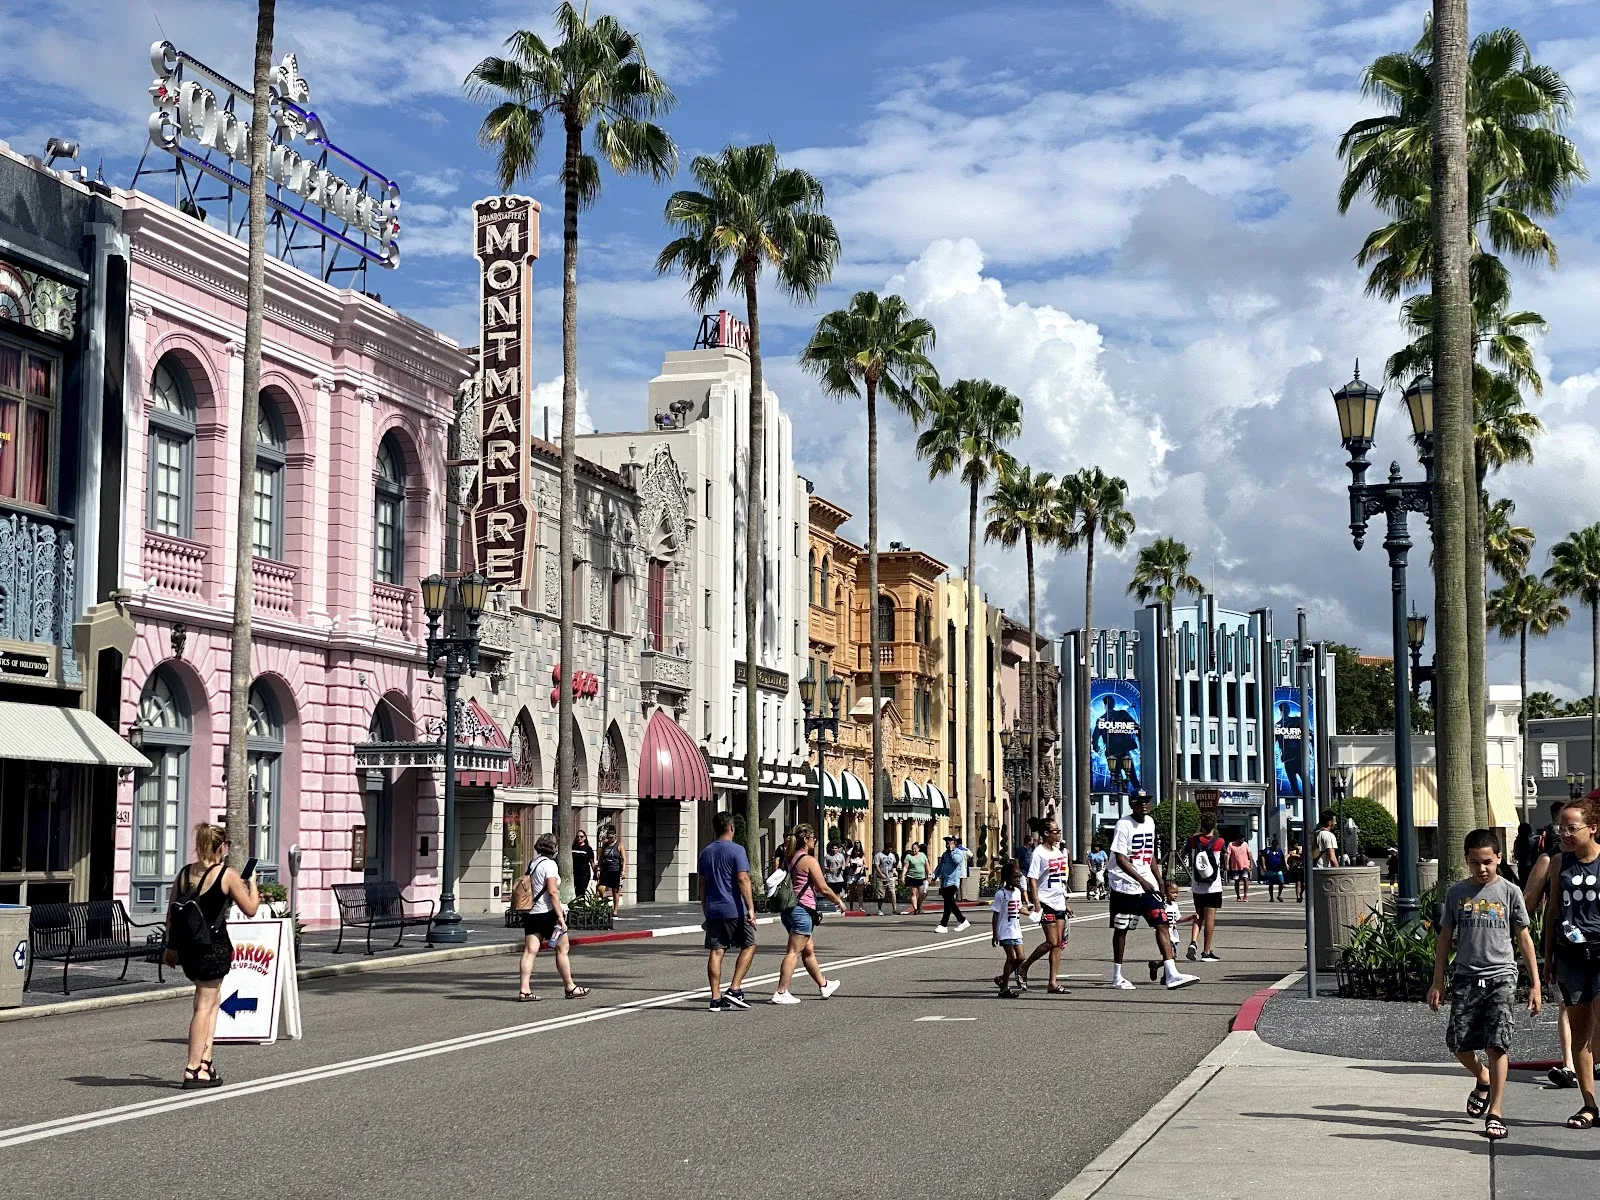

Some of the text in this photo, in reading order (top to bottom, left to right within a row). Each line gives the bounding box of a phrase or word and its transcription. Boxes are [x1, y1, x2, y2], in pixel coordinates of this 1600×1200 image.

[485, 222, 519, 579] MONTMARTRE
[20, 661, 48, 671] HOLLYWOOD
[1098, 721, 1135, 730] BOURNE
[1274, 727, 1302, 735] BOURN
[1196, 793, 1217, 801] BEVERLY
[1219, 790, 1250, 799] OURNE
[1571, 872, 1597, 886] do
[1563, 890, 1600, 907] goo
[249, 963, 268, 976] SHOW
